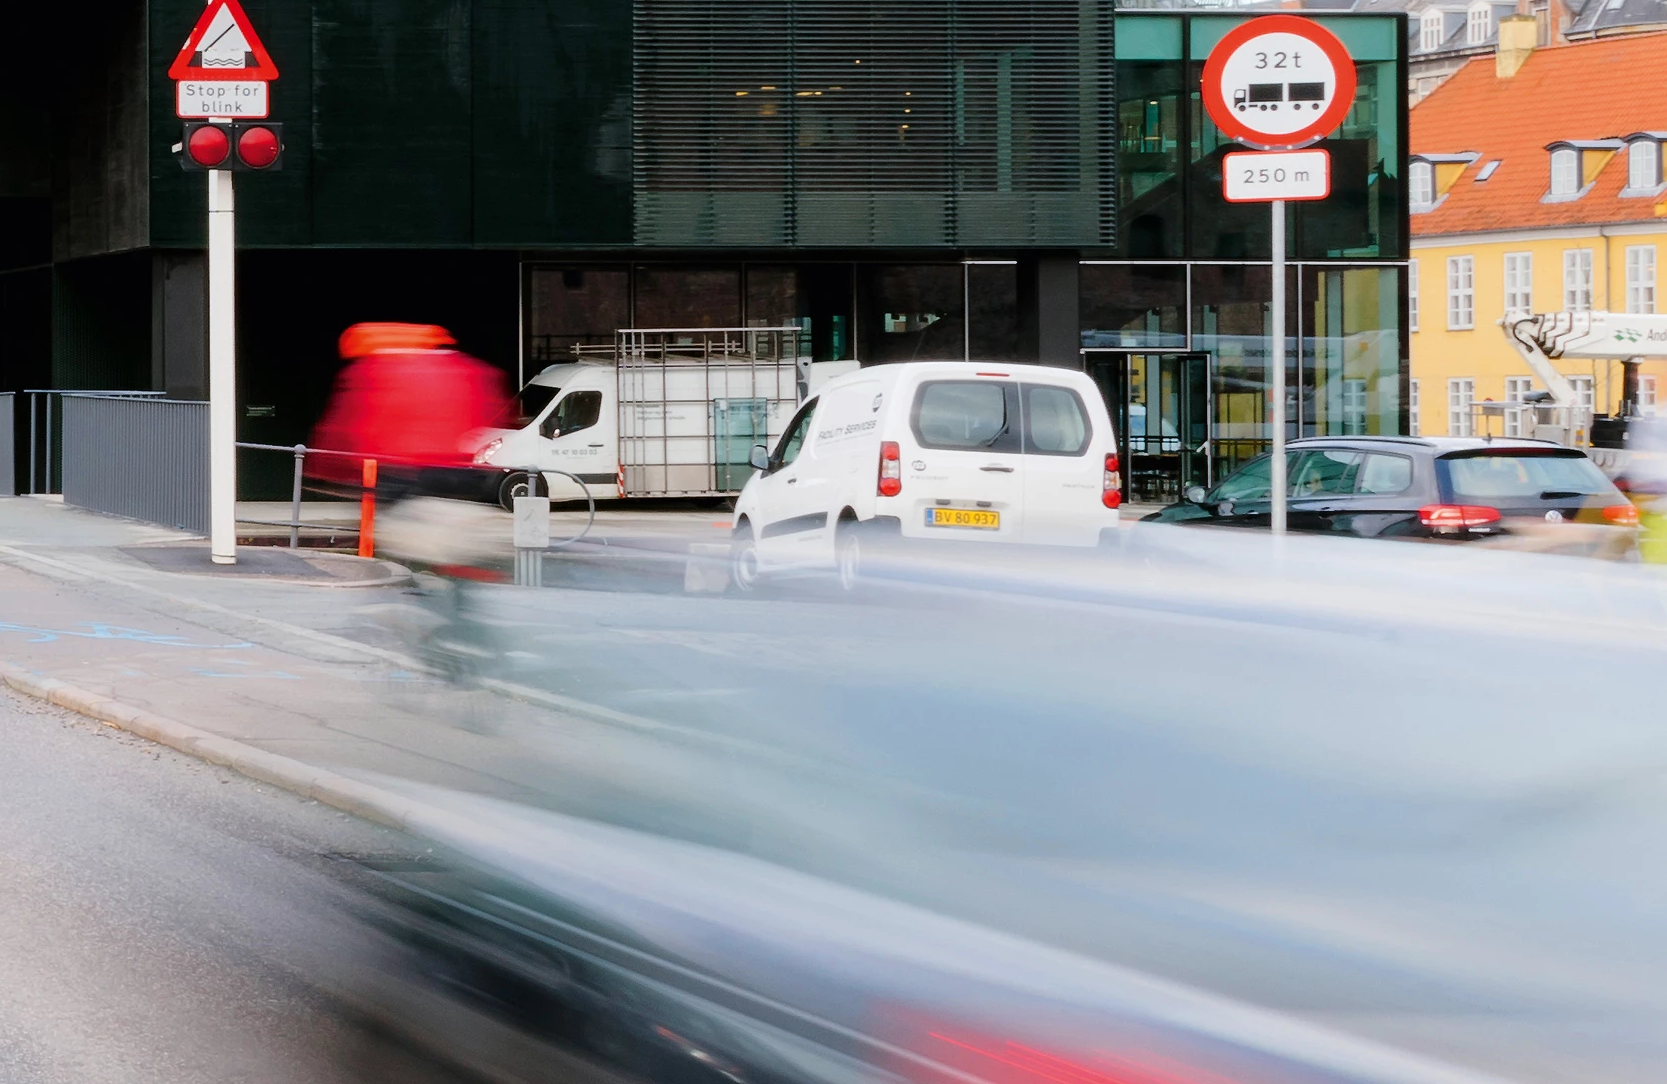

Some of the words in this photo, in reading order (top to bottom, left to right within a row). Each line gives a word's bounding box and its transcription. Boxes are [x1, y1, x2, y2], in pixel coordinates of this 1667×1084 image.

[186, 84, 225, 98] Stop
[234, 84, 258, 96] for
[202, 101, 243, 113] blink
[1243, 168, 1286, 184] 250
[1294, 170, 1310, 182] m
[935, 511, 952, 523] BV
[955, 512, 970, 524] 80
[973, 513, 997, 525] 937
